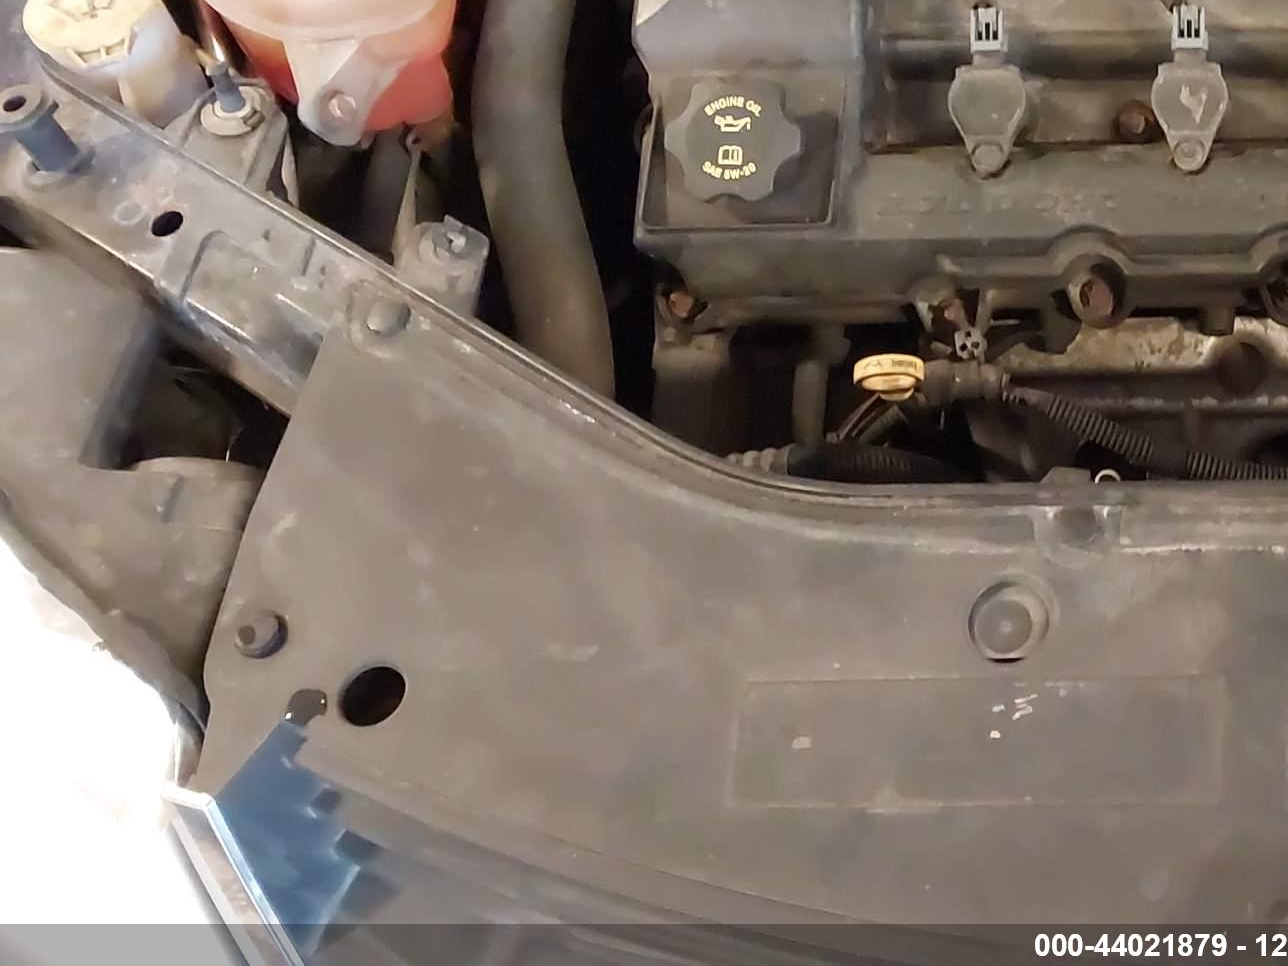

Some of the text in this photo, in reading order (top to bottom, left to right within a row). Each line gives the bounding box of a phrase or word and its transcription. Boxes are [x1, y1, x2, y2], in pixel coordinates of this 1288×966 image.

[704, 96, 762, 117] ENGINE OIL
[702, 161, 757, 180] SAE 5W-20
